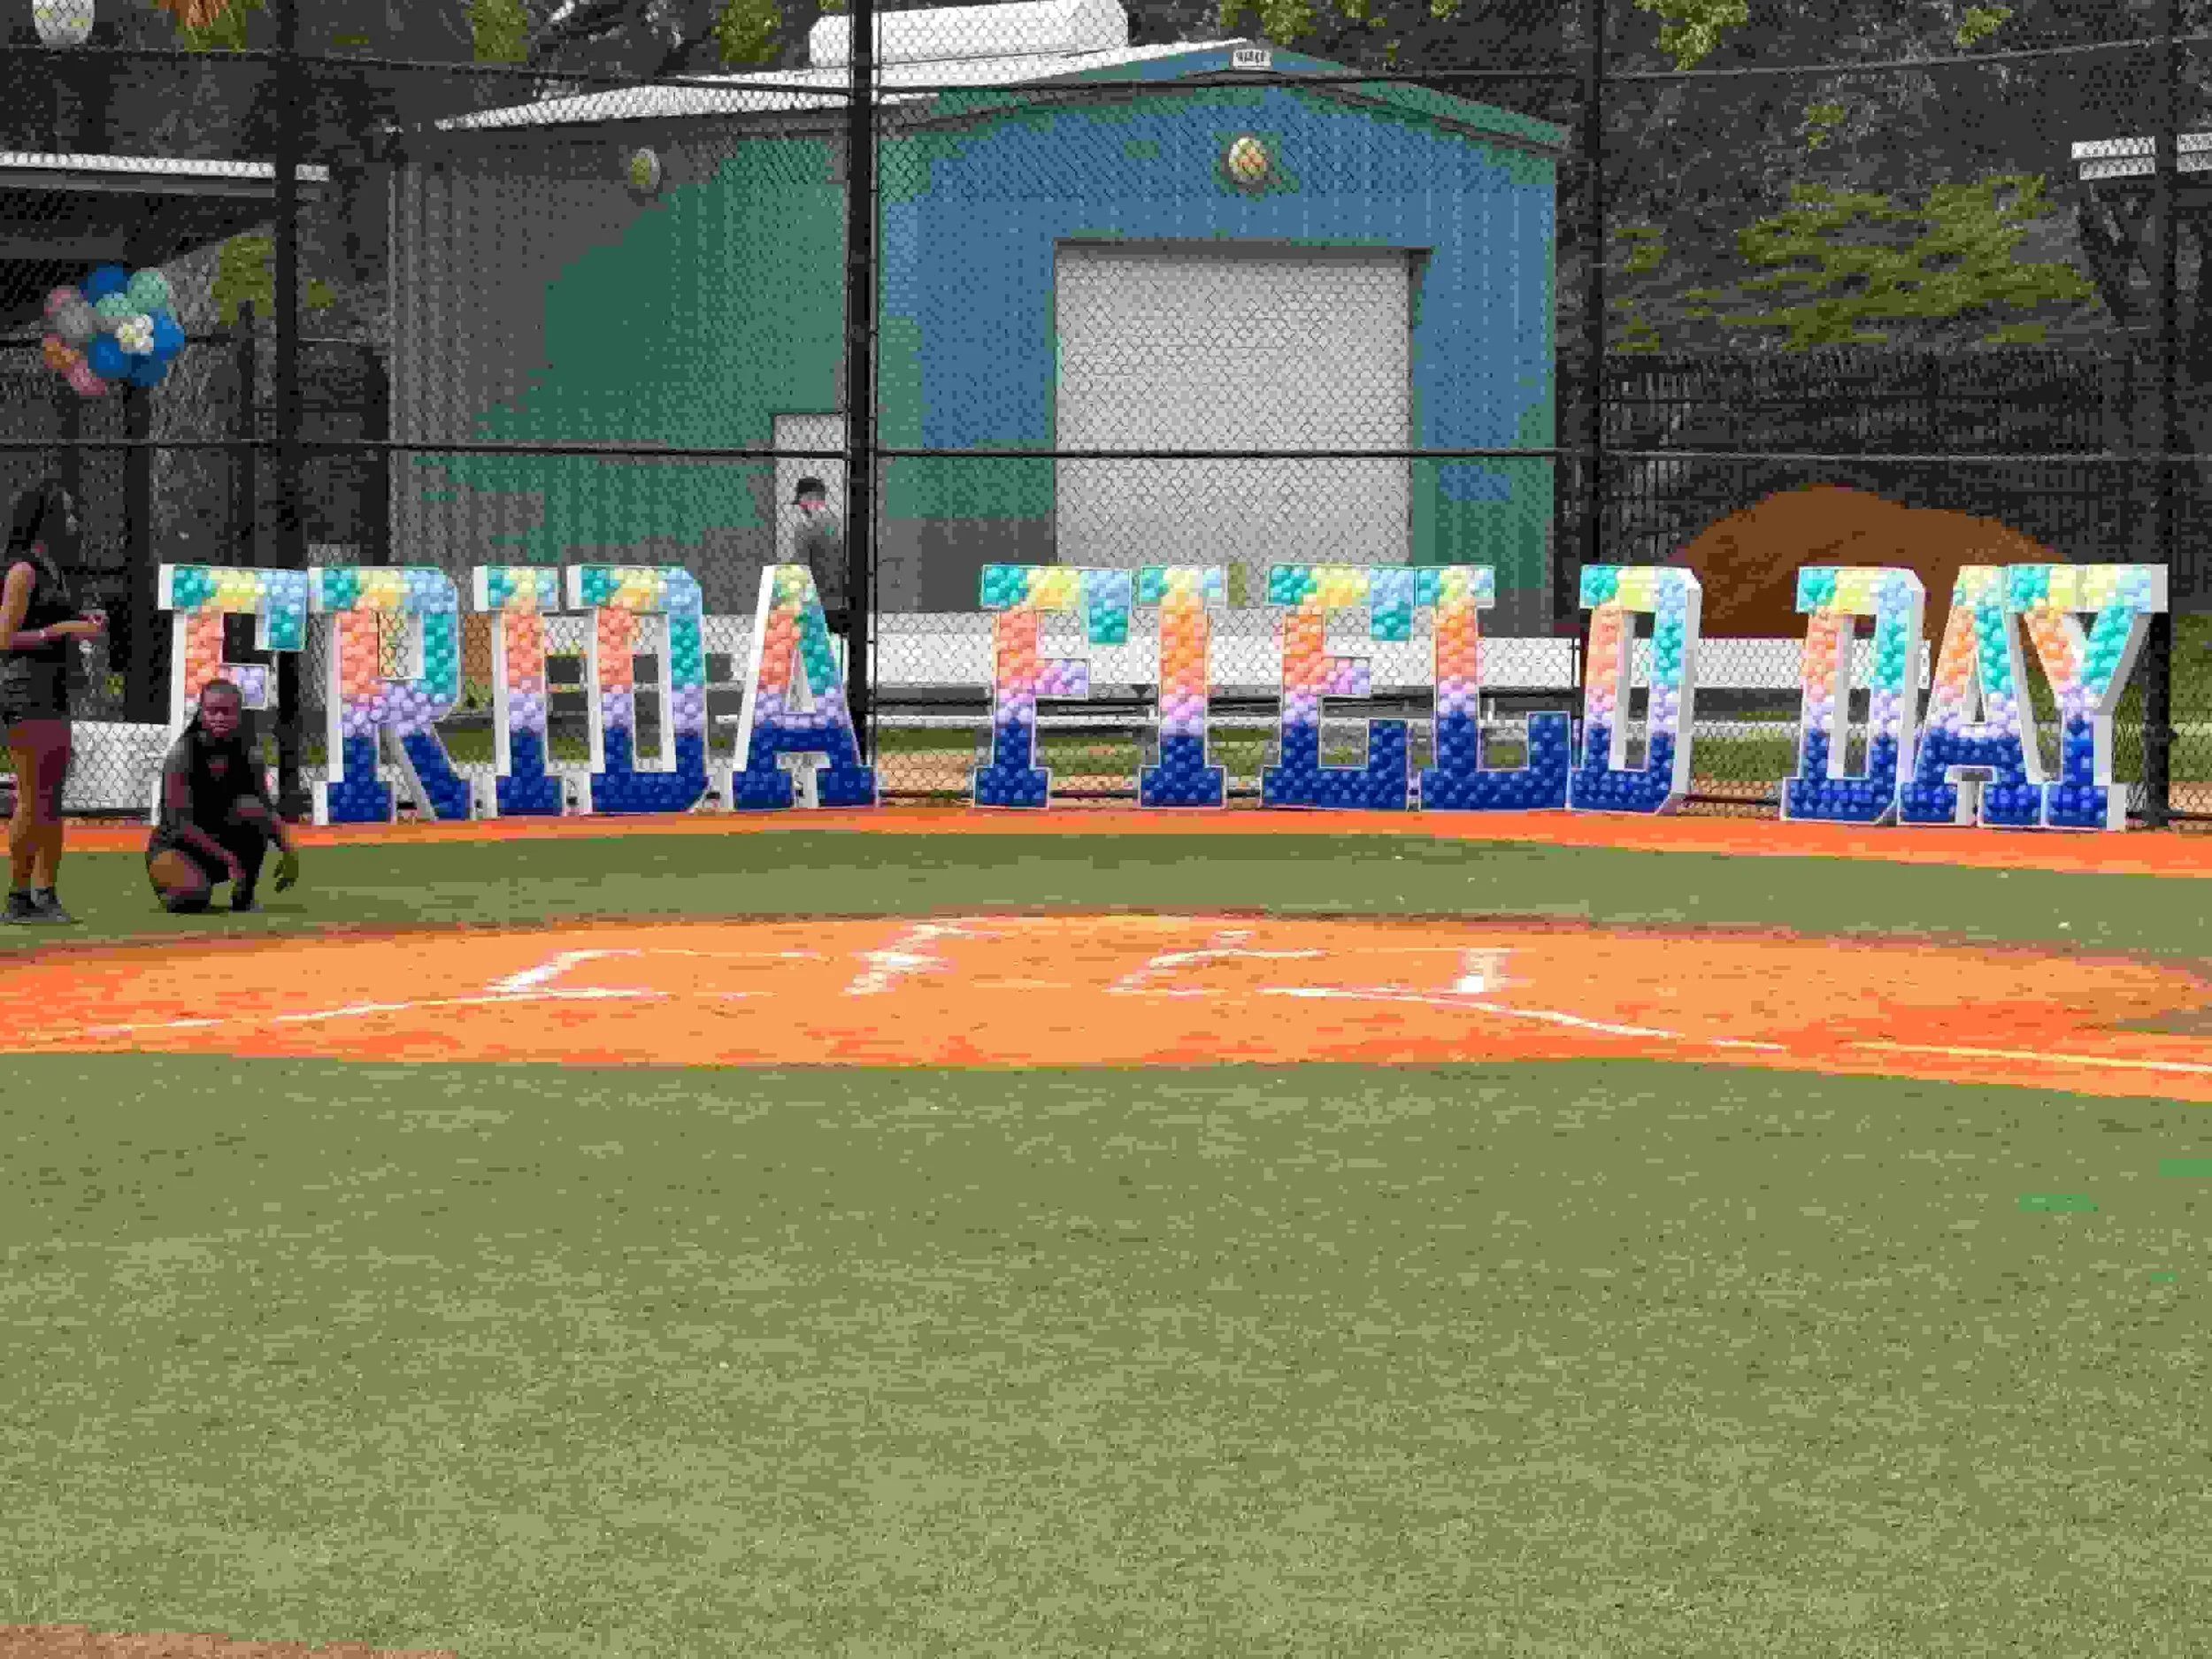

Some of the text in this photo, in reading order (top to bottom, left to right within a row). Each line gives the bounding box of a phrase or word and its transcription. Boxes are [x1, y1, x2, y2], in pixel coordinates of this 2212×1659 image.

[154, 564, 2168, 833] FRIDA FIELD DAY
